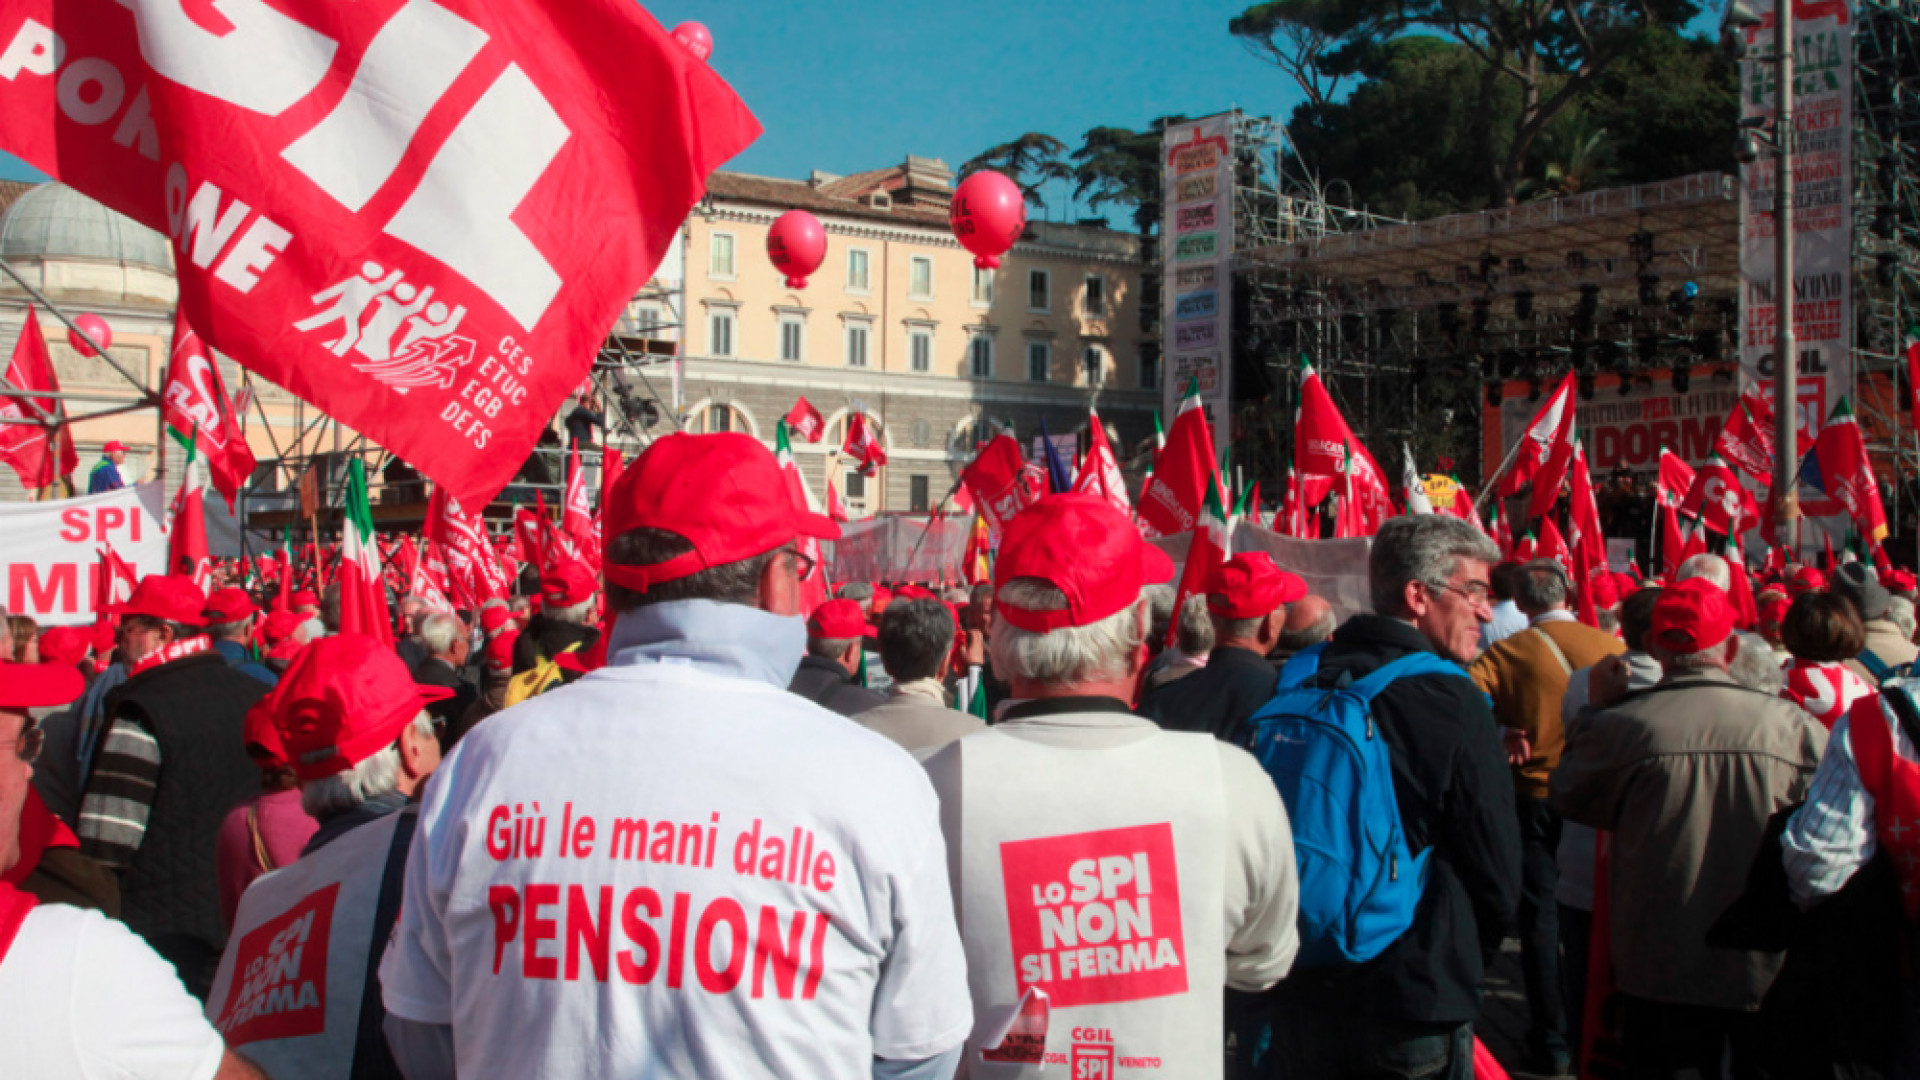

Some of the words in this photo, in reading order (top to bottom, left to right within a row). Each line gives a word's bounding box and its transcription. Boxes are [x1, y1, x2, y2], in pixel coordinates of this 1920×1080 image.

[498, 335, 535, 375] CES
[1757, 349, 1828, 376] CIL
[460, 379, 503, 418] EGB
[478, 355, 528, 406] ETUC
[440, 401, 493, 450] DEFS
[60, 506, 141, 543] SPI
[487, 801, 546, 861] Giù
[559, 801, 596, 859] le
[609, 811, 720, 869] mani
[733, 818, 835, 892] dalle
[1032, 882, 1067, 906] LO
[1068, 852, 1152, 903] SPI
[489, 883, 831, 1000] PENSIONI
[1038, 895, 1153, 950] NON
[1020, 953, 1053, 983] SI
[1059, 938, 1180, 980] FERMA
[1071, 1027, 1115, 1043] CGIL
[1077, 1058, 1109, 1080] SPI
[1117, 1056, 1163, 1069] VENETO
